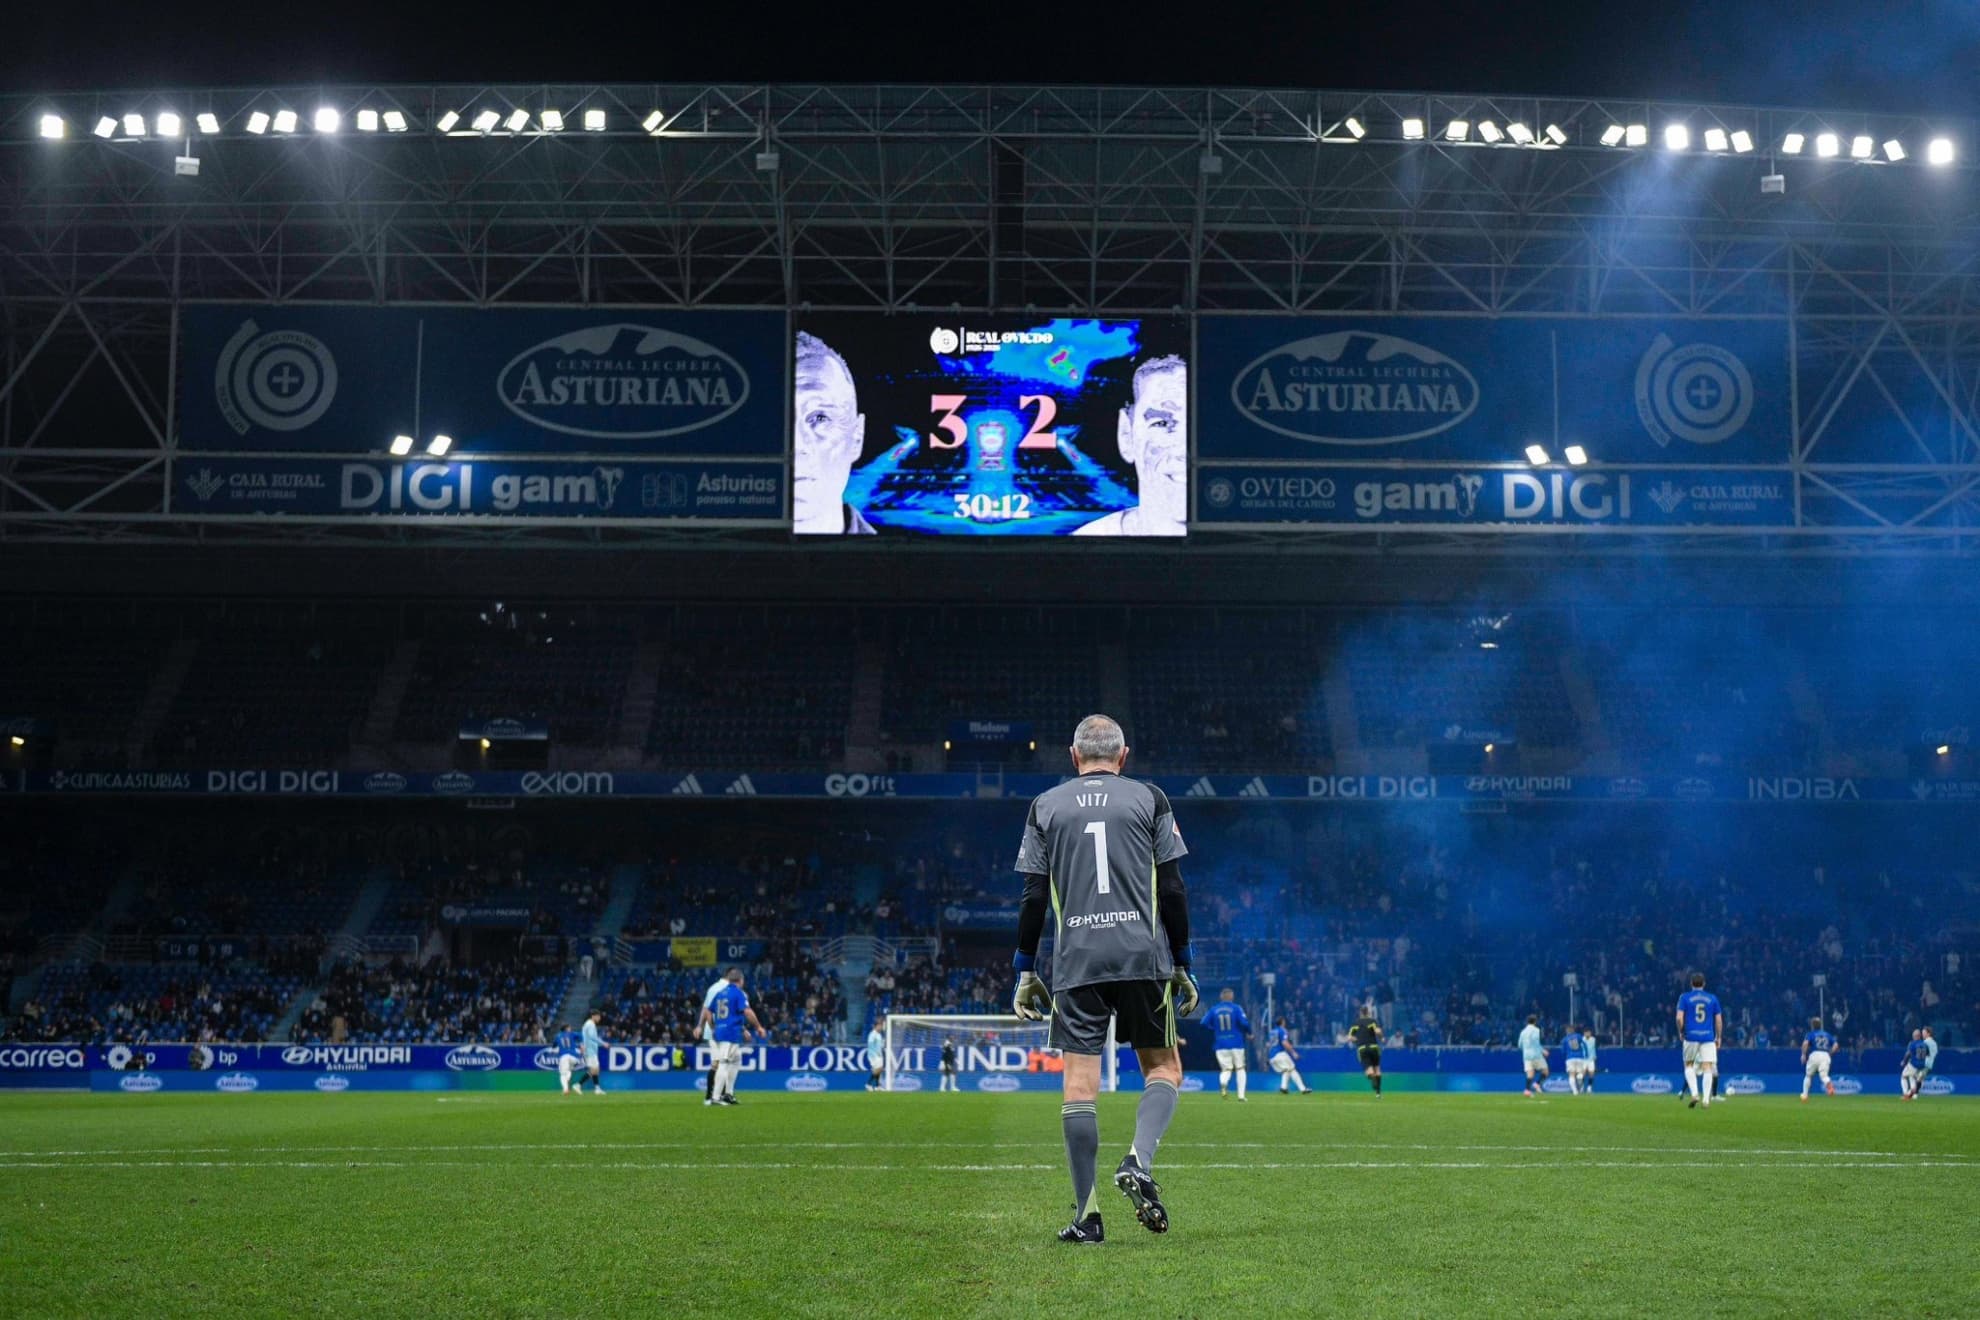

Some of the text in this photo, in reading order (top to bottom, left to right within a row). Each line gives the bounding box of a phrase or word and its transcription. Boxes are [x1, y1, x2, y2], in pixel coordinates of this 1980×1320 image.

[556, 359, 722, 372] CENTRAL LECHERA
[1289, 366, 1451, 378] CENTRAL LECHERA
[514, 361, 733, 406] ASTURIANA
[1249, 367, 1463, 412] ASTURIANA
[929, 394, 968, 449] 3
[1018, 394, 1057, 448] 2
[229, 474, 325, 488] CAJA RURAL
[341, 463, 473, 510] DIGI
[696, 472, 776, 491] Asturias
[1240, 477, 1336, 498] OVIEDO
[1691, 485, 1783, 498] CAJA RURAL
[492, 475, 596, 510] gam
[1354, 481, 1456, 517] gam
[1502, 473, 1631, 518] DIGI
[953, 493, 1030, 519] 30:12
[207, 771, 339, 792] DIGI DIGI
[521, 771, 614, 793] exiom
[1307, 776, 1437, 798] DIGI DIGI
[1491, 776, 1571, 790] HYUNDAI
[1749, 777, 1861, 800] INDIBA
[1076, 793, 1109, 808] VITI
[1084, 821, 1110, 894] 1
[1084, 910, 1140, 925] HYUNDAI
[1218, 1014, 1232, 1031] 11
[1695, 1003, 1706, 1023] 5
[219, 1051, 238, 1066] bp
[314, 1047, 411, 1064] HYUNDAI
[451, 1053, 498, 1066] ASTURIANA
[609, 1047, 676, 1071] DIG
[695, 1047, 767, 1071] DGI
